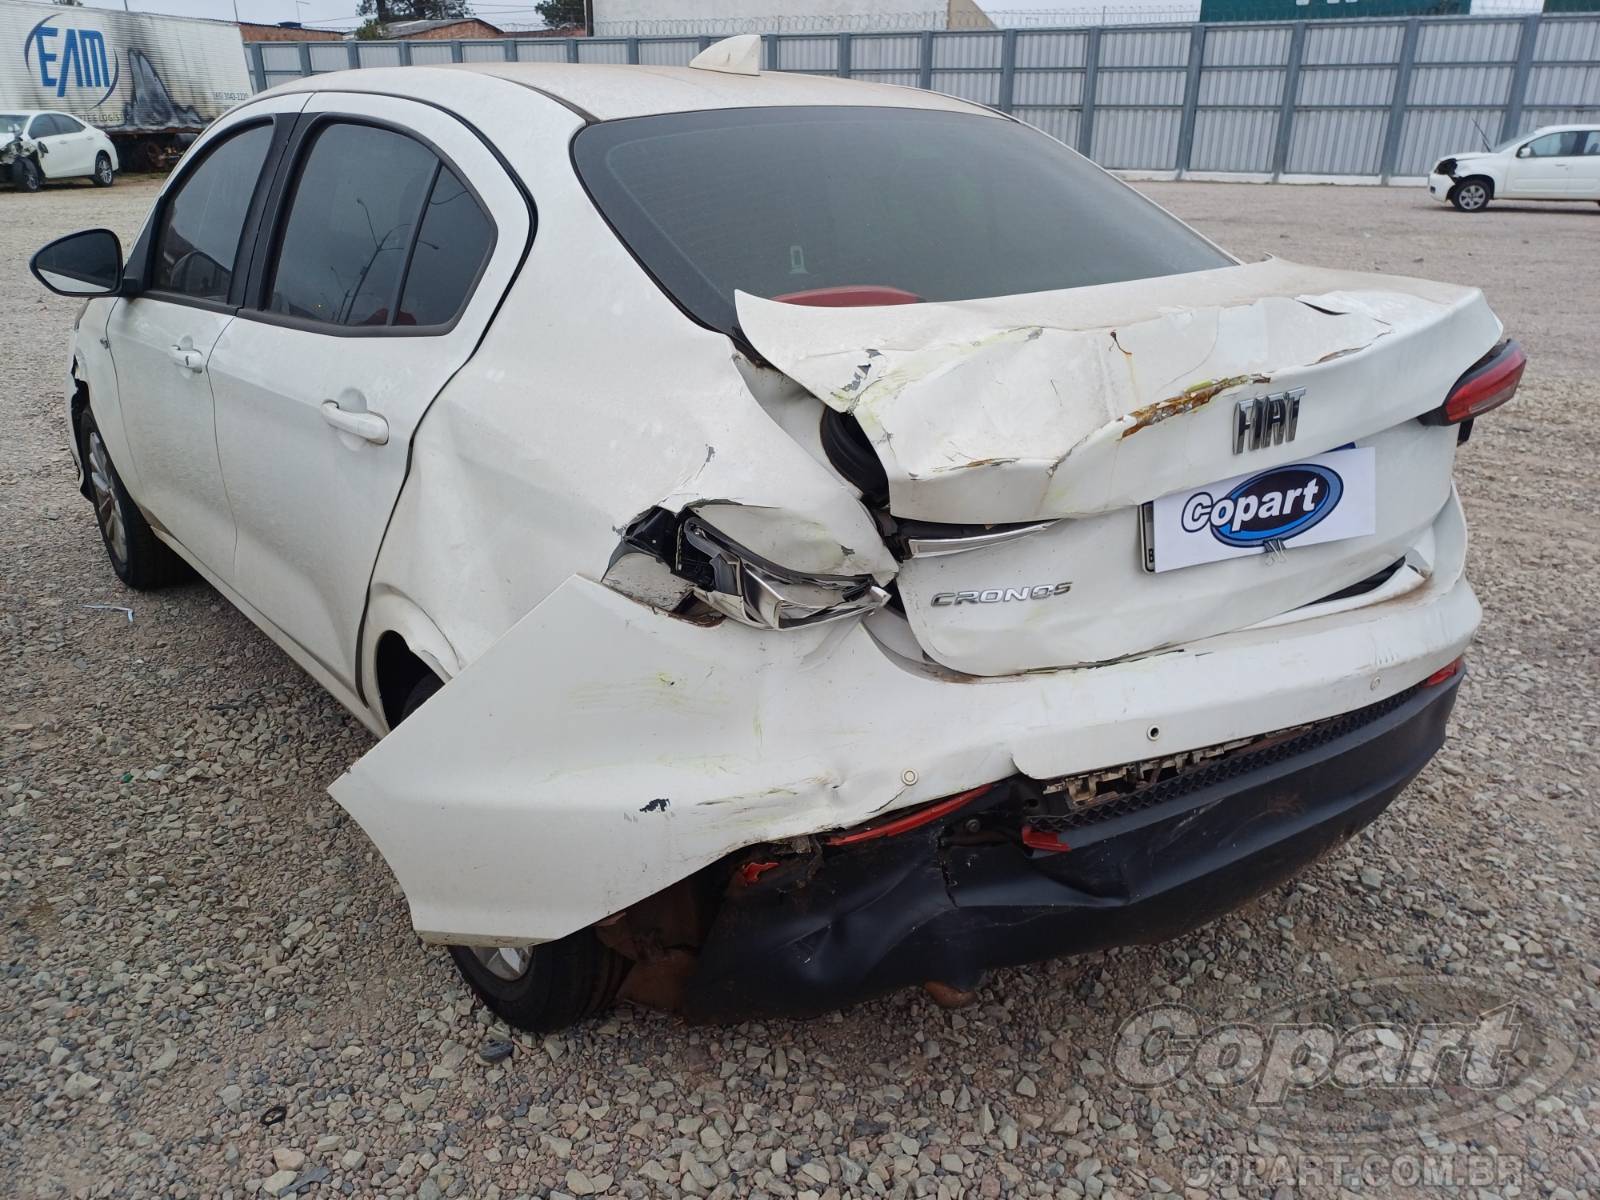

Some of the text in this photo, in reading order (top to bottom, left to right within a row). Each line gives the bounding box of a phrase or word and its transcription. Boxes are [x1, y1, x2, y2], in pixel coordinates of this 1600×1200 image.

[35, 26, 110, 97] EAM
[1232, 386, 1306, 455] FIAT
[1182, 477, 1319, 533] Copart
[930, 581, 1073, 607] CRONOS
